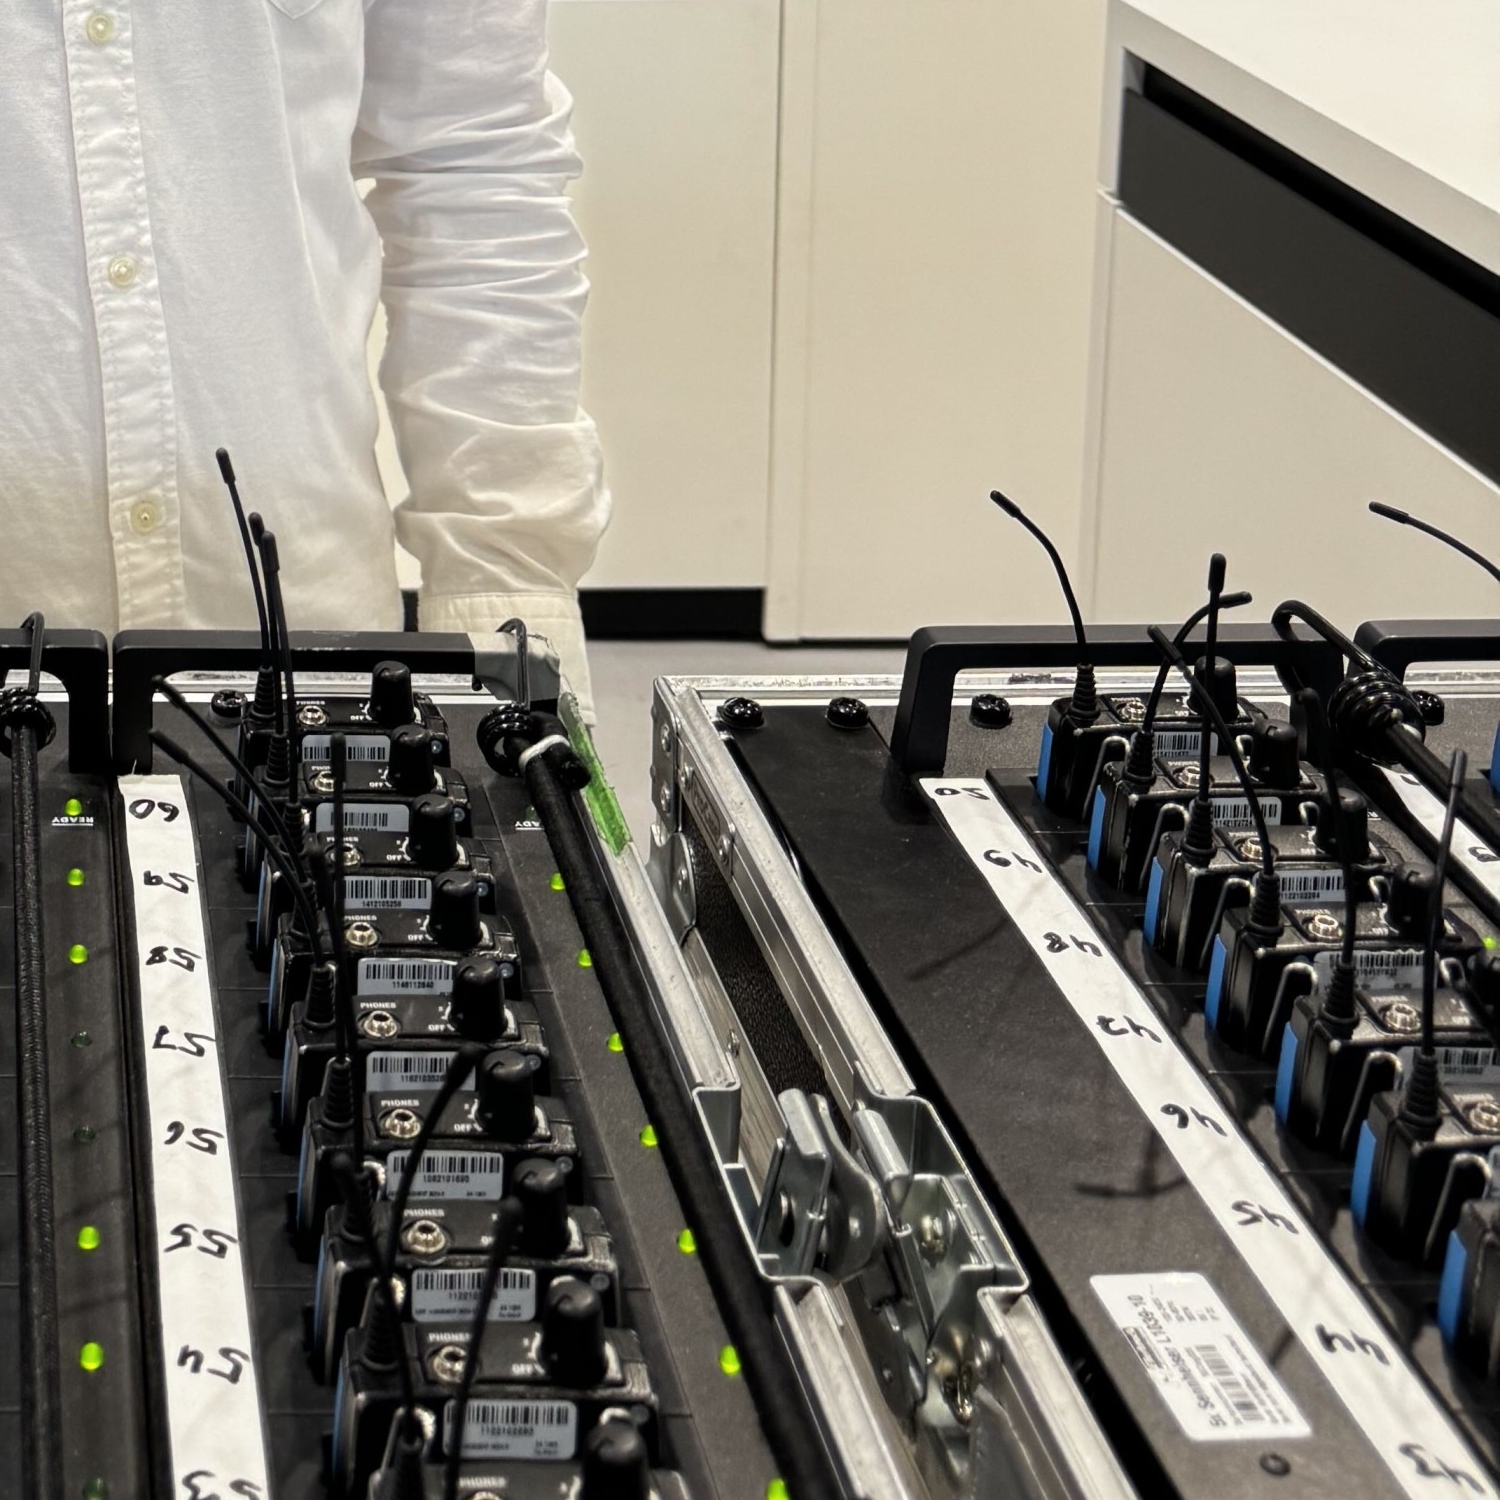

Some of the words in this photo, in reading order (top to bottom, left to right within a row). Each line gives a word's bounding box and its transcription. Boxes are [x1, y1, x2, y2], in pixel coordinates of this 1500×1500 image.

[934, 785, 990, 802] 50
[50, 816, 94, 824] READY
[129, 797, 181, 824] 60
[983, 849, 1043, 873] 49
[143, 868, 199, 896] 59
[145, 945, 202, 974] 58
[1041, 931, 1104, 958] 48
[360, 1002, 397, 1010] PHONES
[151, 1025, 216, 1059] 57
[1094, 1011, 1165, 1044] 47
[380, 1099, 420, 1108] PHONES
[1159, 1101, 1229, 1137] 46
[164, 1120, 226, 1156] 56
[403, 1208, 446, 1218] PHONES
[1230, 1197, 1300, 1236] 45
[164, 1222, 238, 1260] 55
[1318, 1322, 1394, 1368] 44
[177, 1341, 251, 1385] 54
[1164, 1345, 1216, 1411] Sennheiser
[1398, 1441, 1488, 1496] 43
